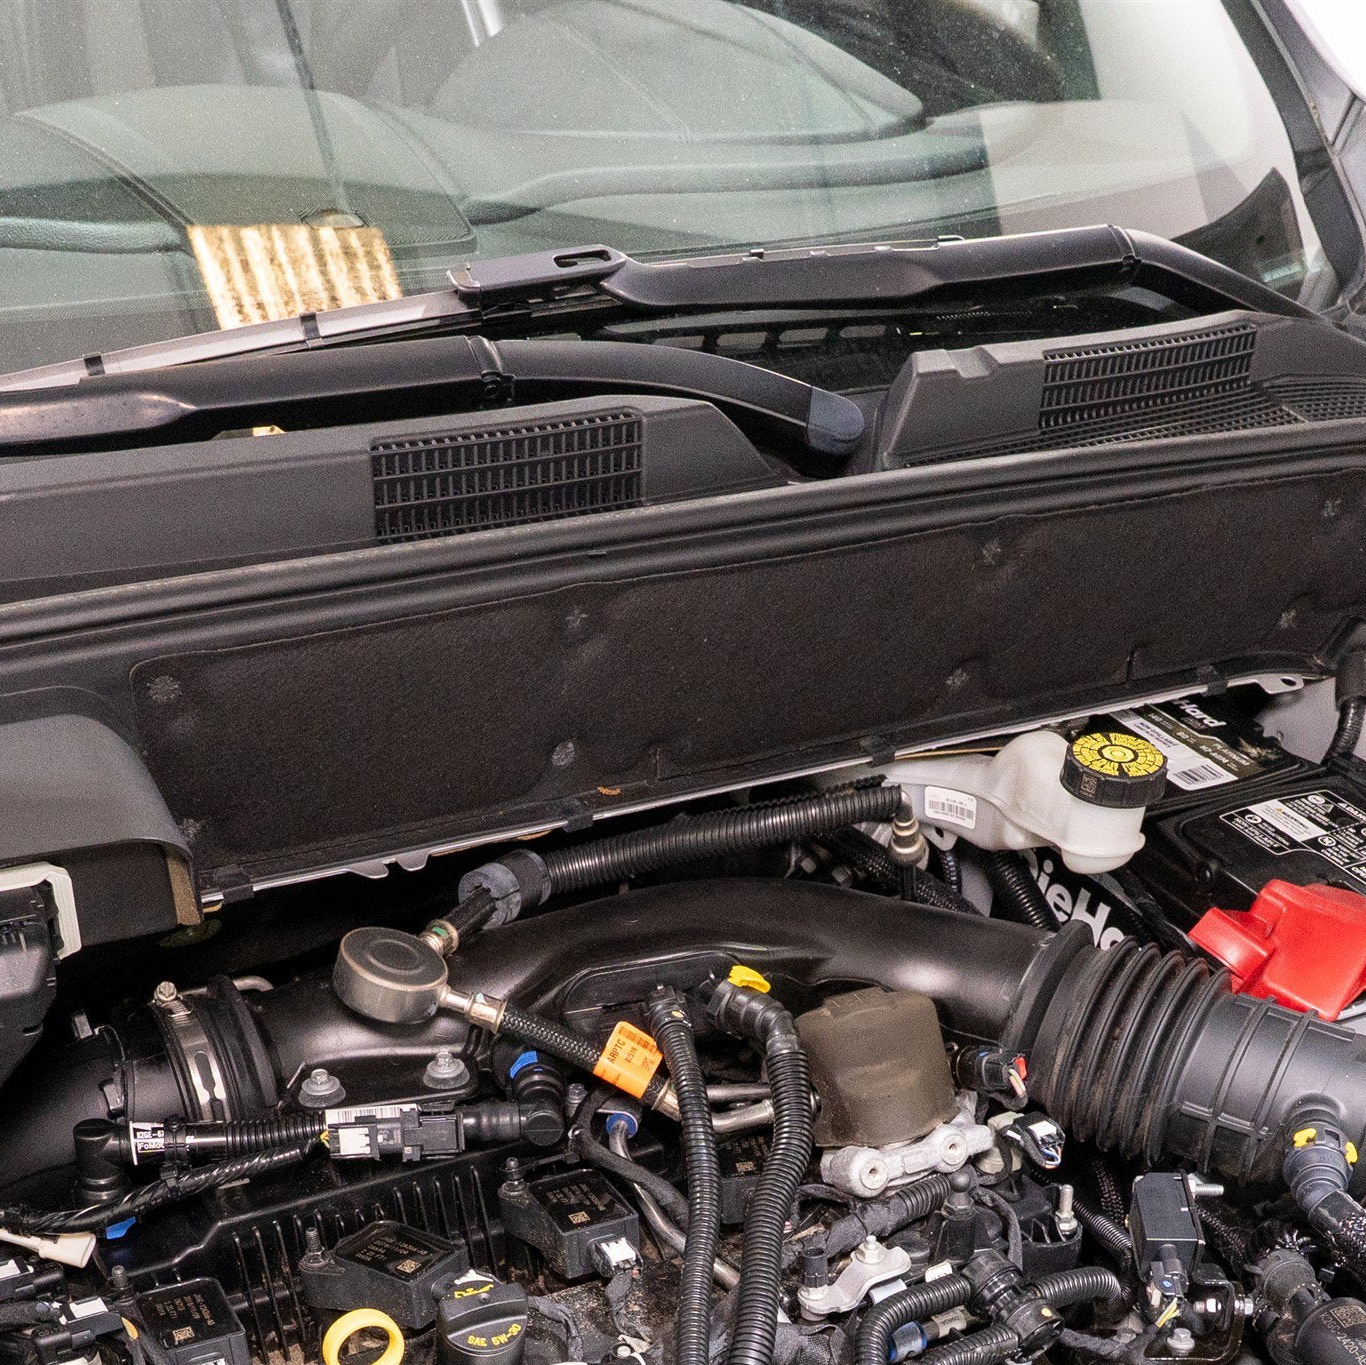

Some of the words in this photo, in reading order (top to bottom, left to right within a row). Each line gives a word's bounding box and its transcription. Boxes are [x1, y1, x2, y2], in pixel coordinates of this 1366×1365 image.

[606, 1038, 625, 1064] ARPTC
[467, 1335, 488, 1347] SAE
[491, 1323, 522, 1346] 5W-30
